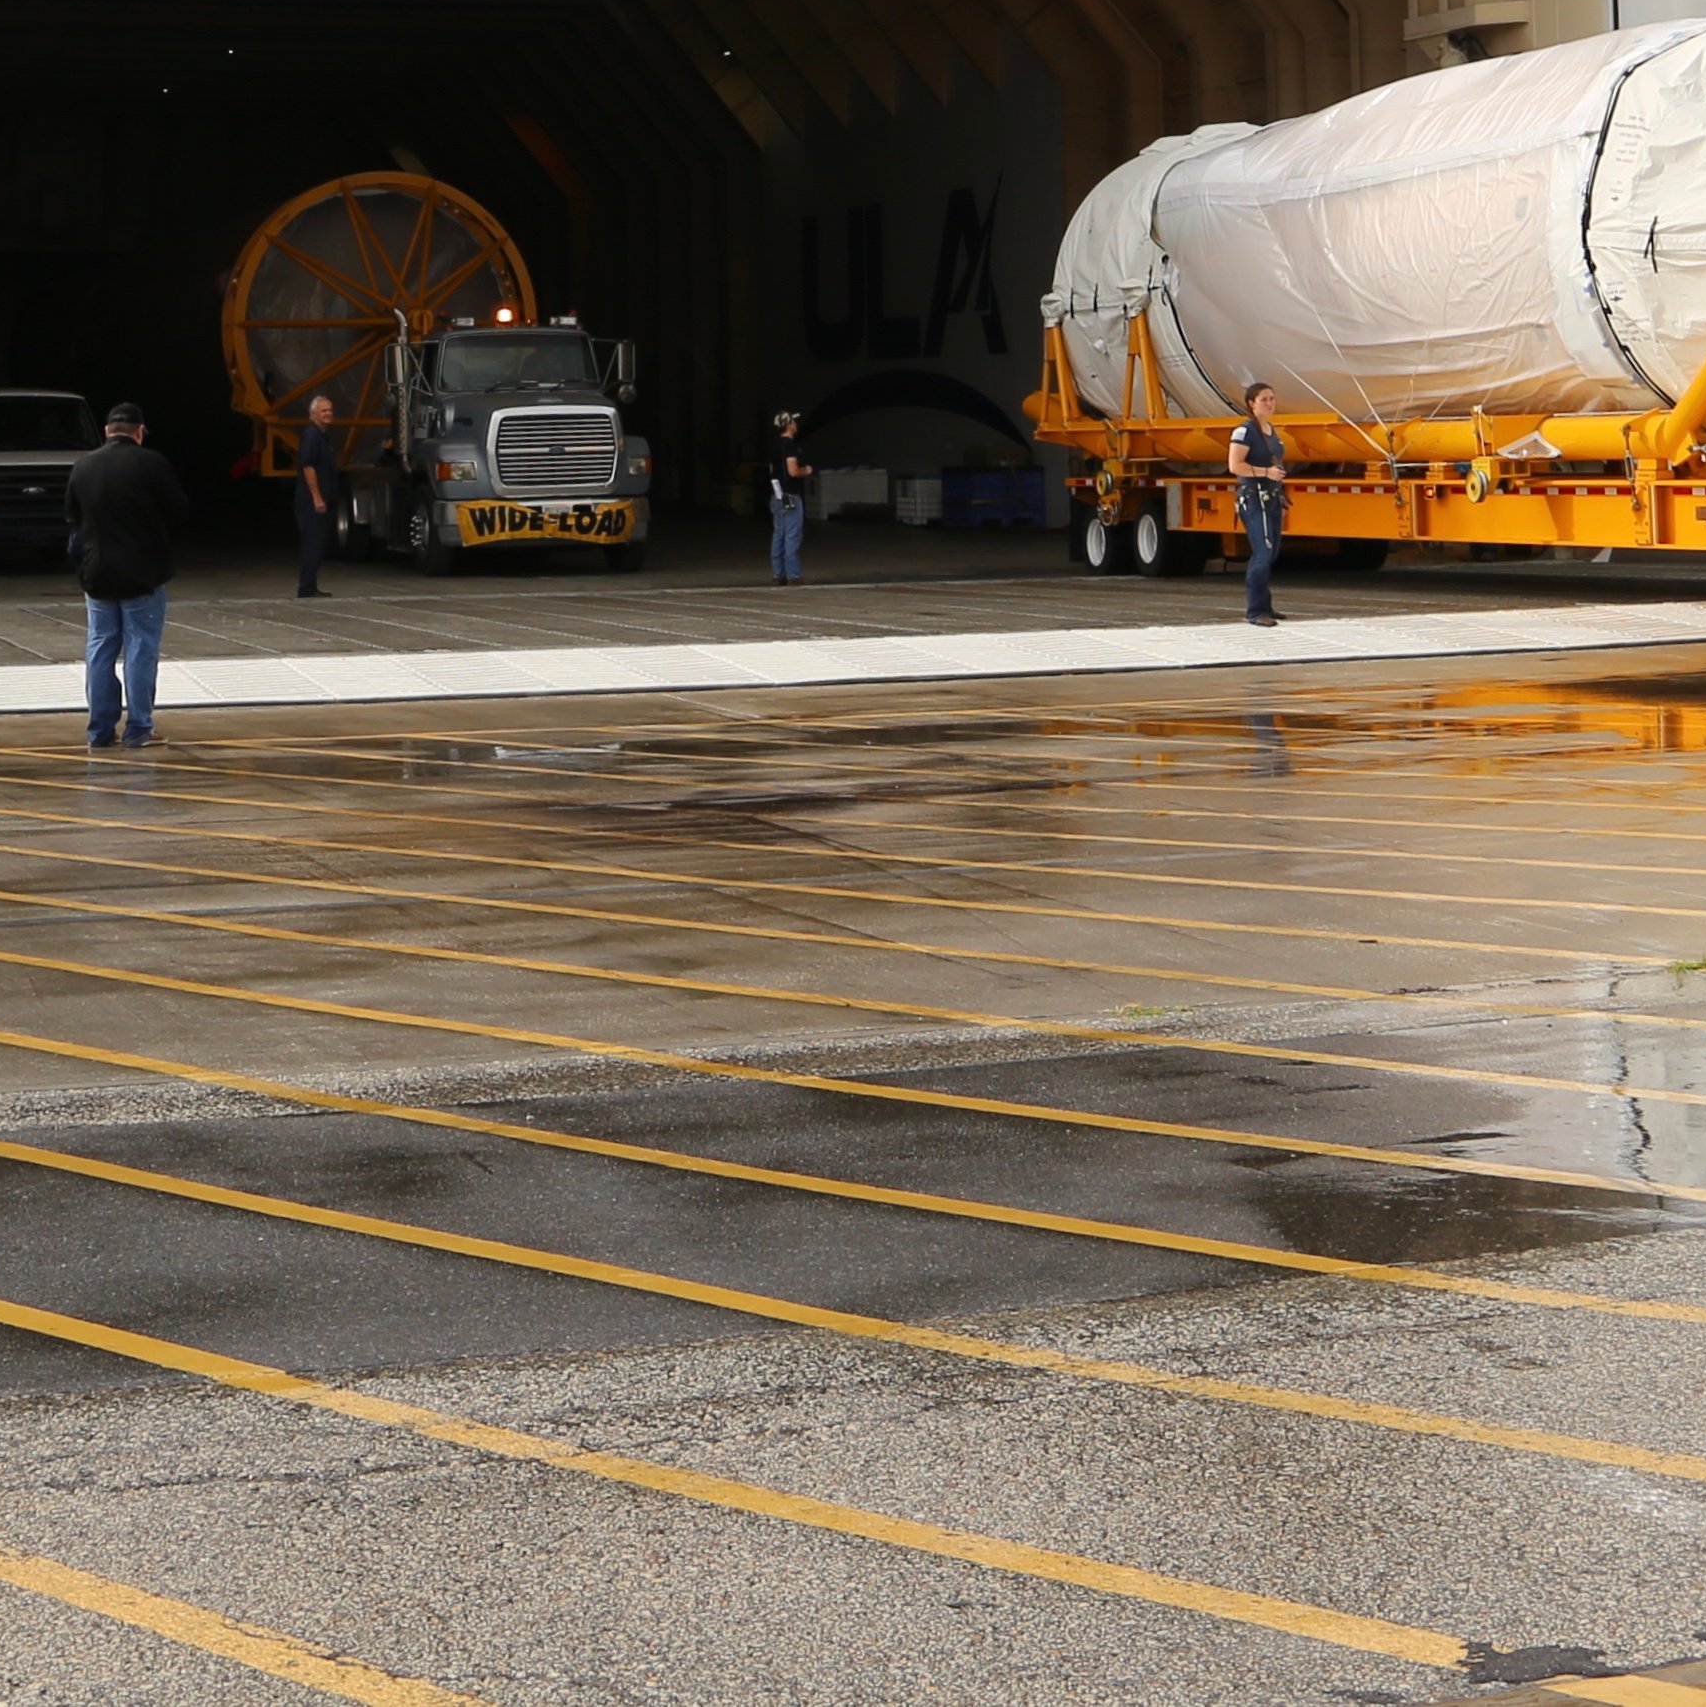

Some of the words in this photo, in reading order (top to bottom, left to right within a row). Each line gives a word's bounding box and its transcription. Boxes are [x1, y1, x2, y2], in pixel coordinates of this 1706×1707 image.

[802, 174, 1008, 361] ULA
[469, 505, 543, 537] WIDE
[558, 504, 626, 537] LOAD
